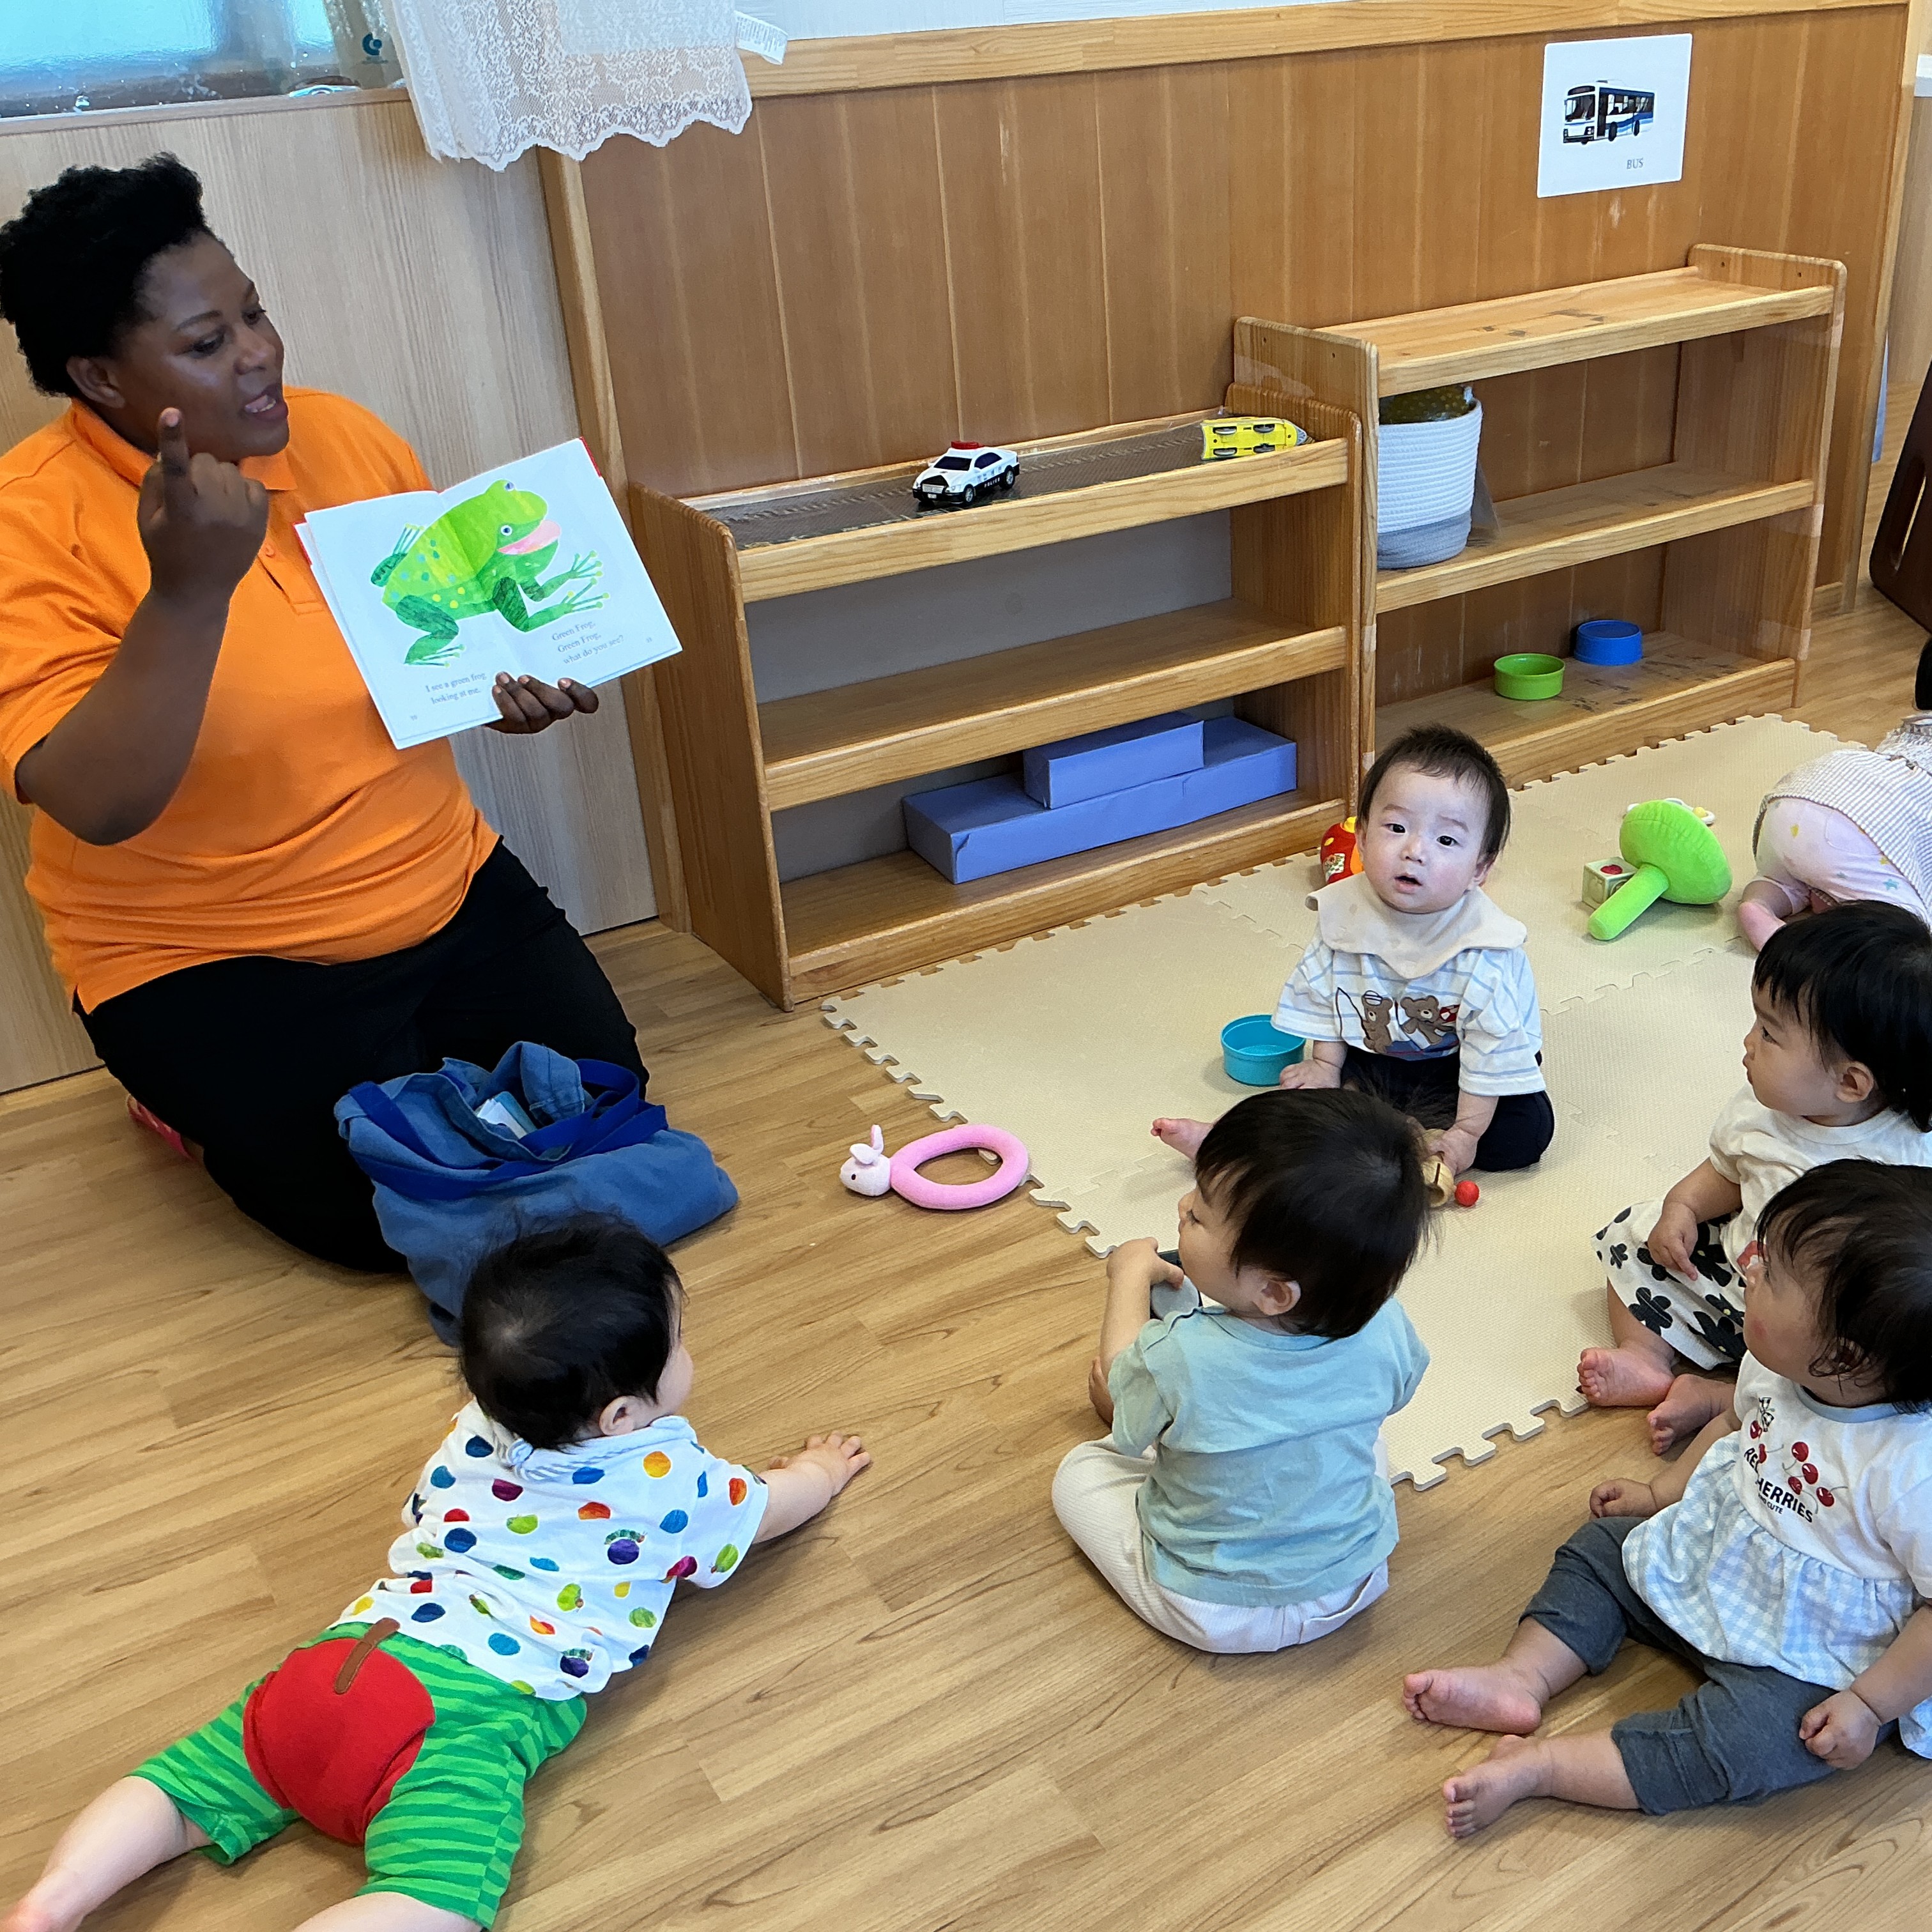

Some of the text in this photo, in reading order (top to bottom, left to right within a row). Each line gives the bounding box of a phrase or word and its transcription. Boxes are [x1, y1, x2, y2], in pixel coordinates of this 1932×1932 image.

[1627, 157, 1643, 169] BUS
[552, 621, 596, 641] Green Frog,
[558, 632, 602, 652] Green Frog,
[564, 634, 624, 664] what do you see?
[450, 677, 470, 688] green
[471, 673, 487, 682] frog
[431, 693, 459, 705] looking
[1755, 1477, 1813, 1523] HERRIES
[1767, 1501, 1783, 1515] CUTE
